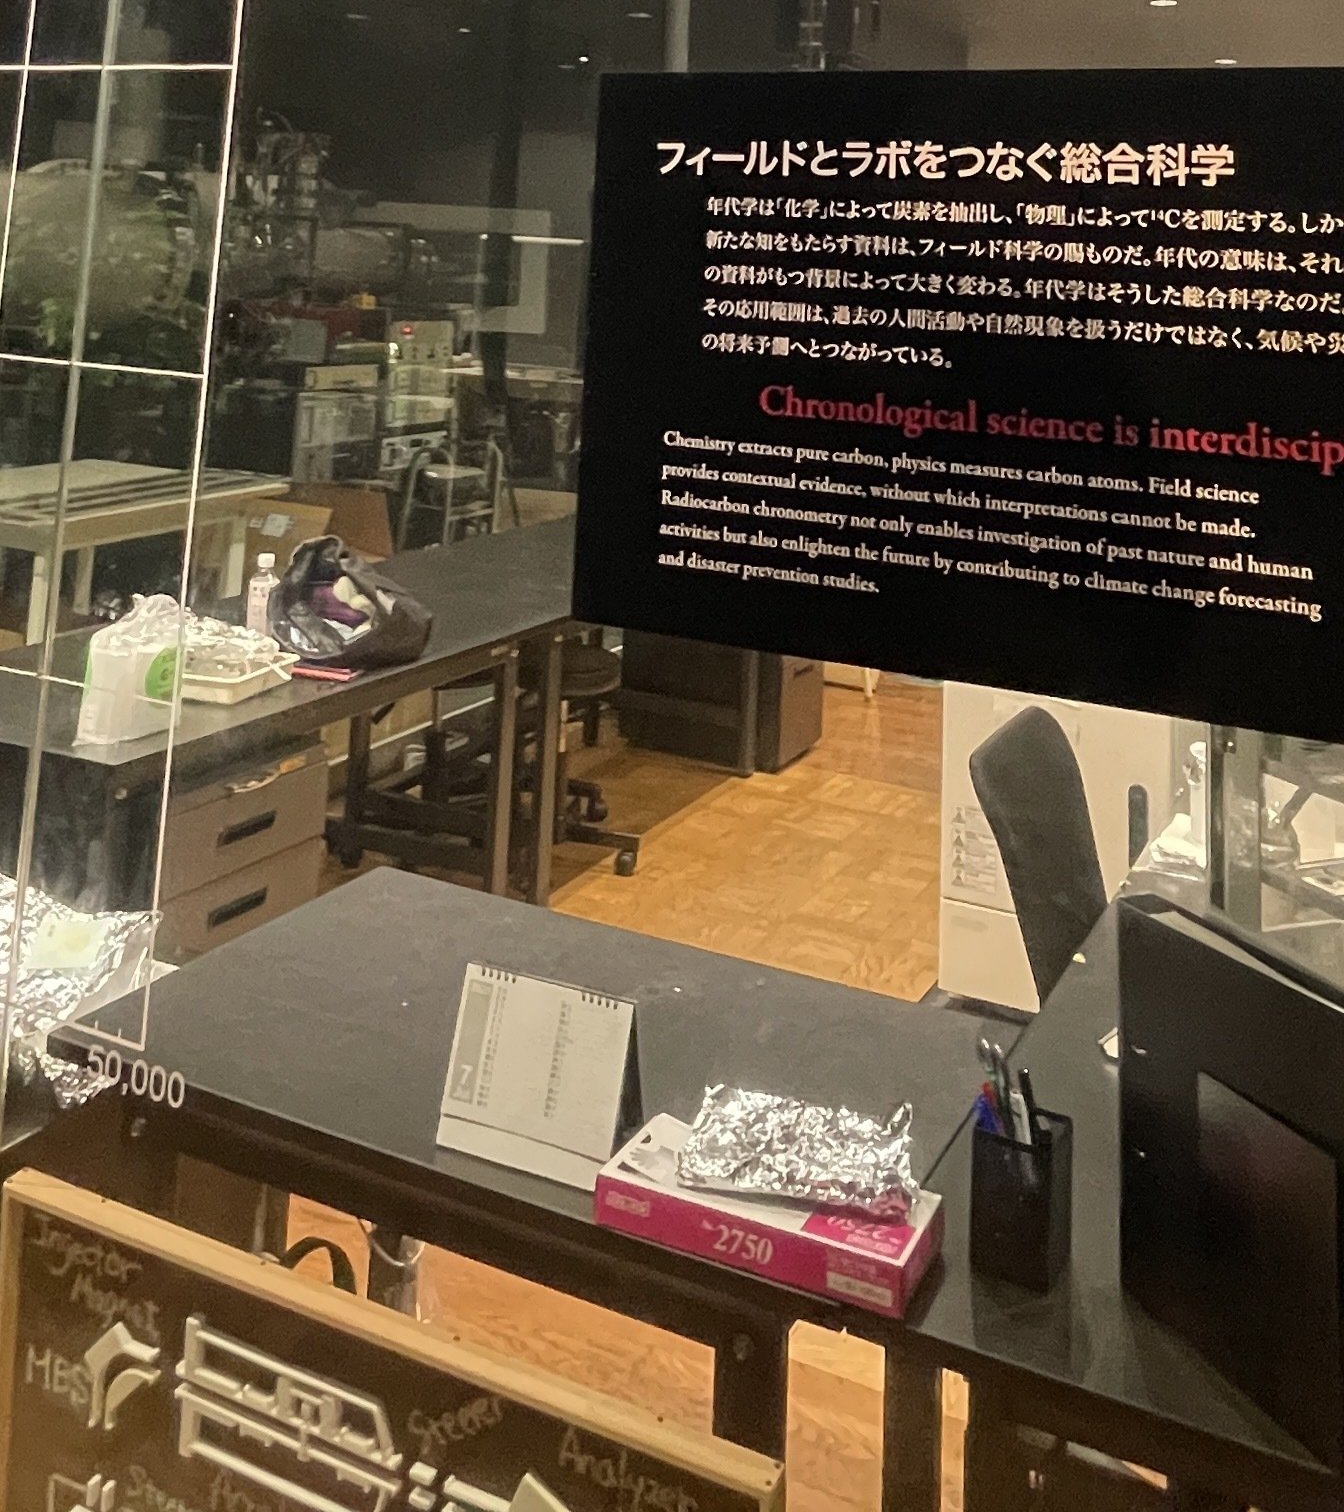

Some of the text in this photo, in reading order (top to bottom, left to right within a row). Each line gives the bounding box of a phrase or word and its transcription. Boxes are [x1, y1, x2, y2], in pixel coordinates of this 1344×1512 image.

[656, 139, 1236, 187] フィールドとラボをつなぐ総合科学
[759, 384, 978, 438] Chronological
[986, 408, 1104, 443] science
[1113, 414, 1140, 446] is
[662, 463, 1256, 538] provides contextual evidence, without which interpretations cannot be made.
[663, 430, 1260, 504] Chemistry extracts pure carbon, physics measures carbon atoms. Field science
[661, 489, 1314, 580] Radiocarbon chronometry not only enables investigation of past nature and human
[658, 550, 880, 593] and disaster prevention studies.
[659, 521, 1322, 622] activities but also enlighten the future by contributing to climate change forecasting
[86, 1044, 186, 1109] 50,000
